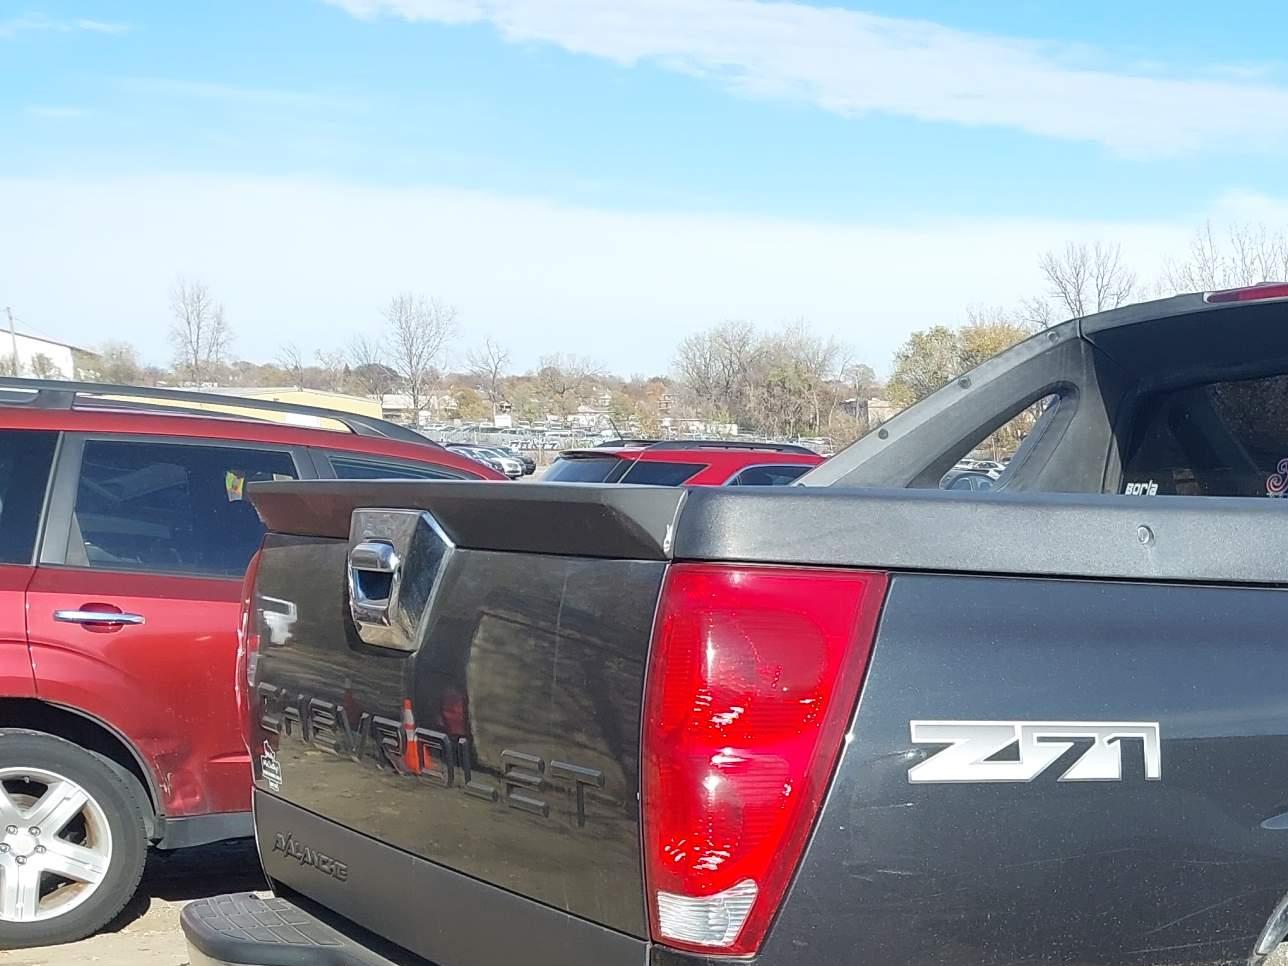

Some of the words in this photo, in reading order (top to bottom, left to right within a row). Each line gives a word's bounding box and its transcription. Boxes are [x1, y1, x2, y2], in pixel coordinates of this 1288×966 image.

[257, 681, 606, 828] CHEVROLET
[908, 719, 1162, 783] Z71
[271, 831, 348, 882] AVALANCHE
